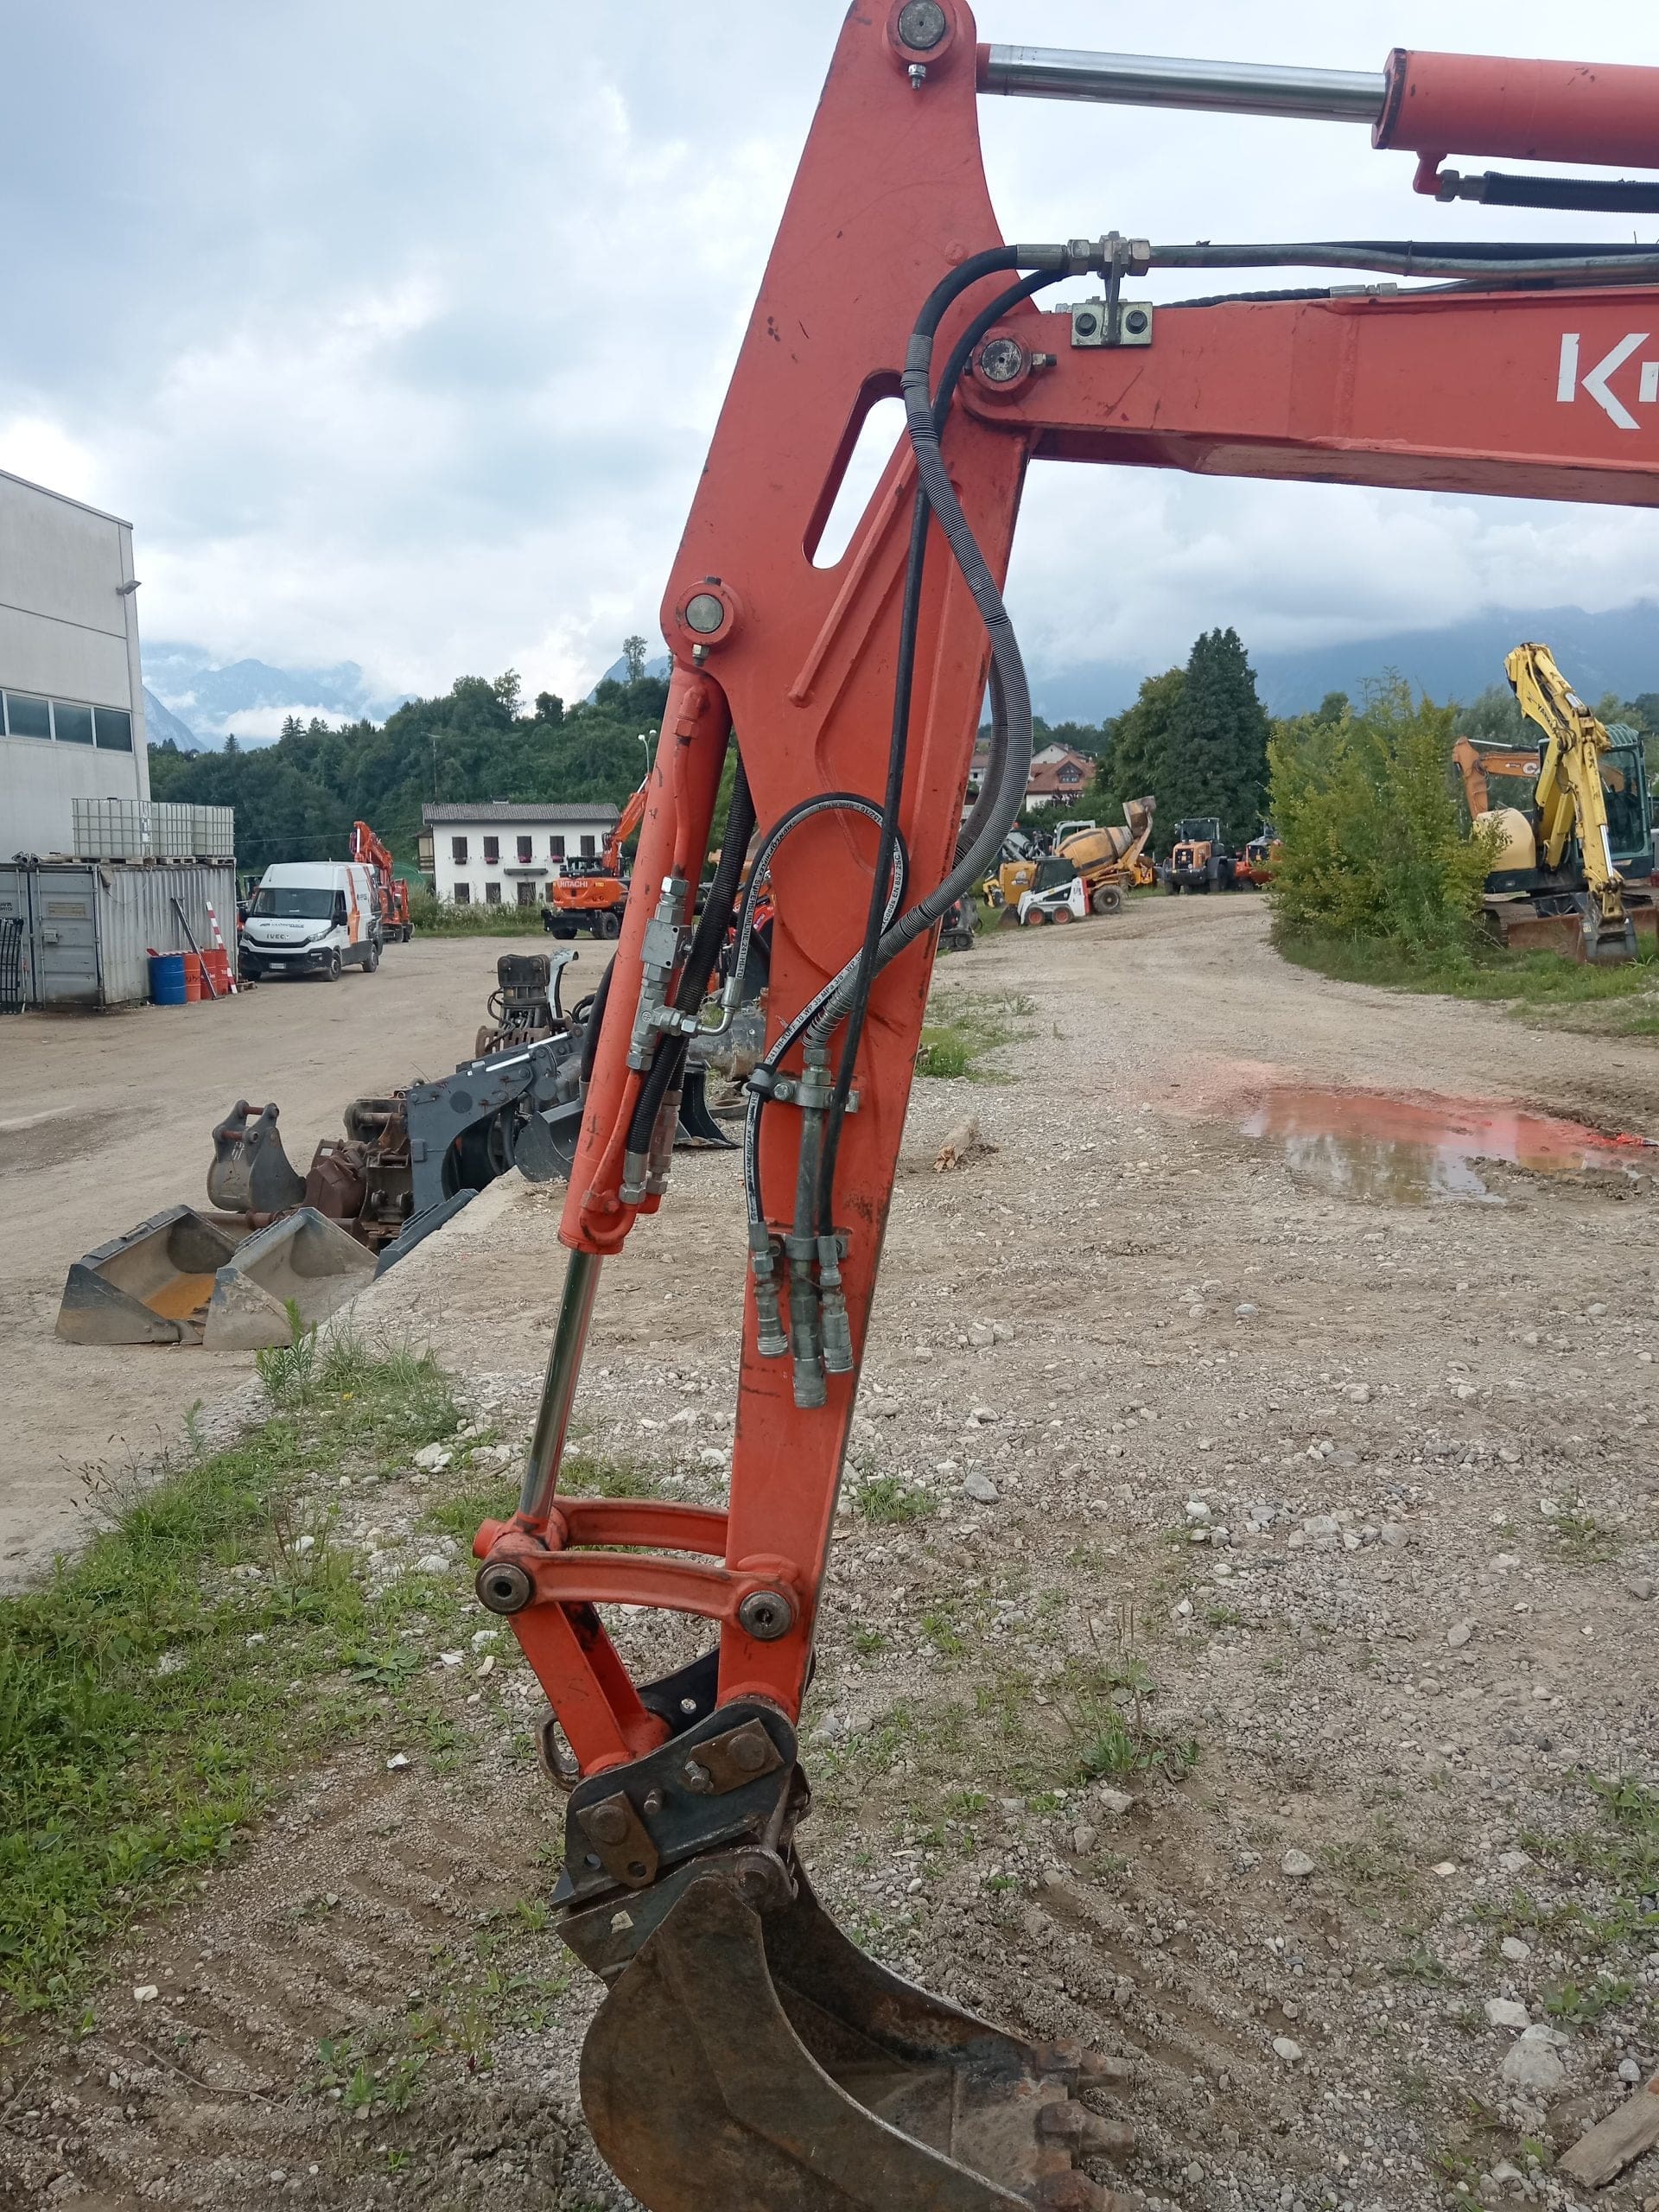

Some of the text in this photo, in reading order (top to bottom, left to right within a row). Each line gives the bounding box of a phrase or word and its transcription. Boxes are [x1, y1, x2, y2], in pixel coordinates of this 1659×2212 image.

[892, 887, 899, 898] EN
[767, 1048, 778, 1062] 241
[776, 1024, 797, 1050] HI-TUFF
[797, 1015, 804, 1024] 10
[803, 1006, 813, 1017] WP
[813, 997, 822, 1006] 35
[821, 984, 835, 998] MPa
[845, 961, 855, 972] WP
